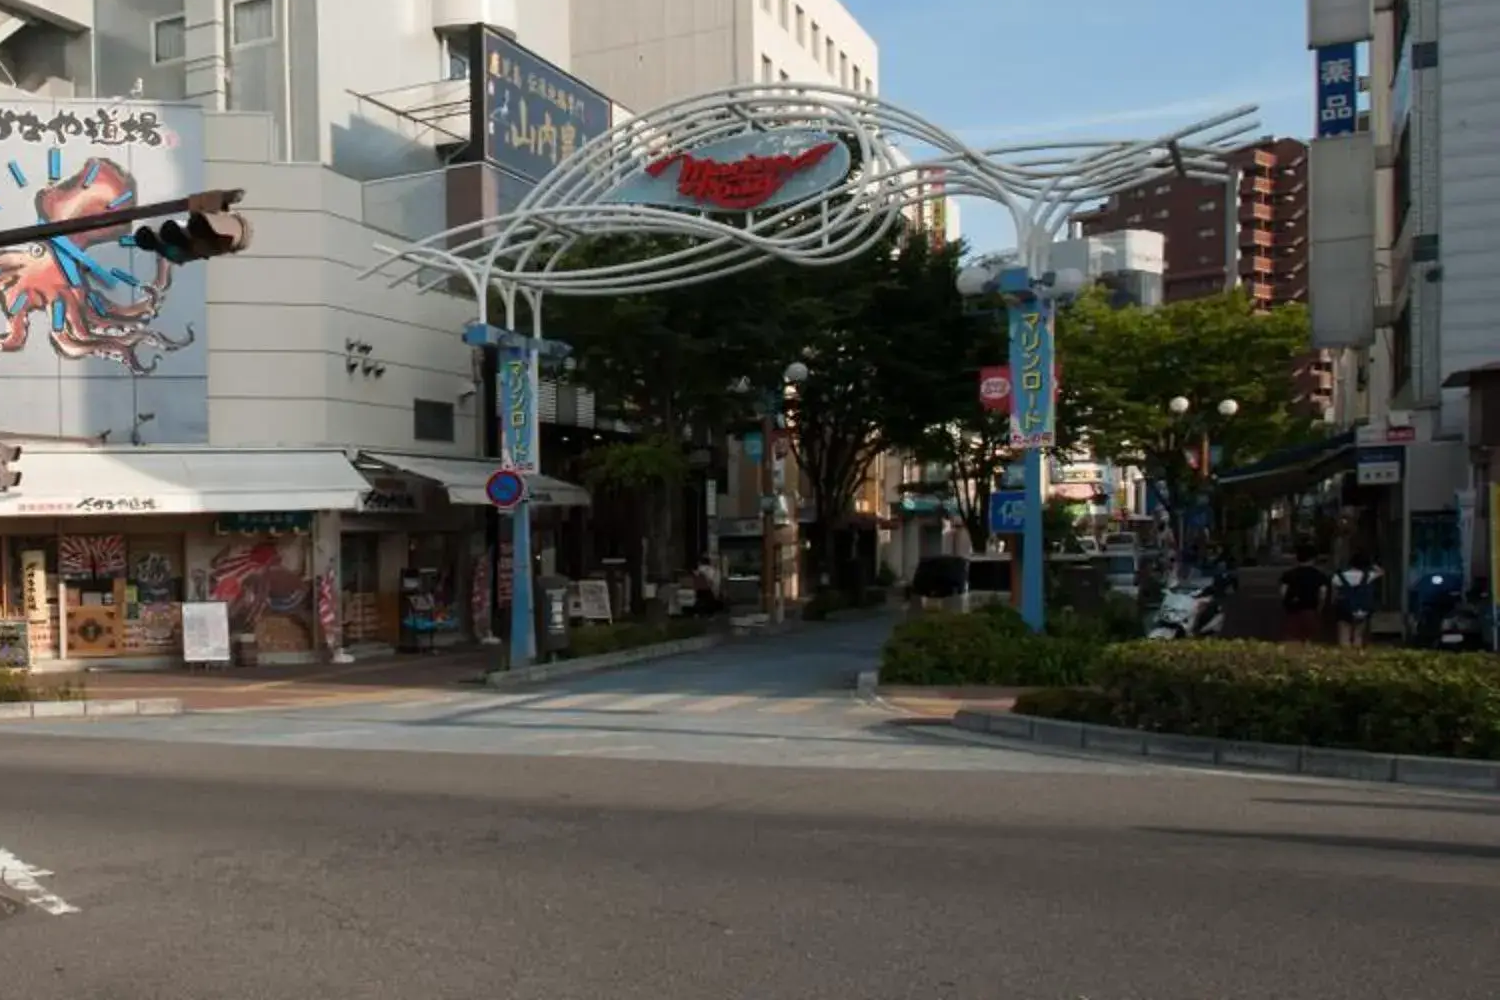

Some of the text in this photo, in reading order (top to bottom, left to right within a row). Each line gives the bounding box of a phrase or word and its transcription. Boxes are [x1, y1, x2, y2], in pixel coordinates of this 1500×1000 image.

[1320, 58, 1352, 137] 薬品
[1021, 312, 1042, 431] マリンロード
